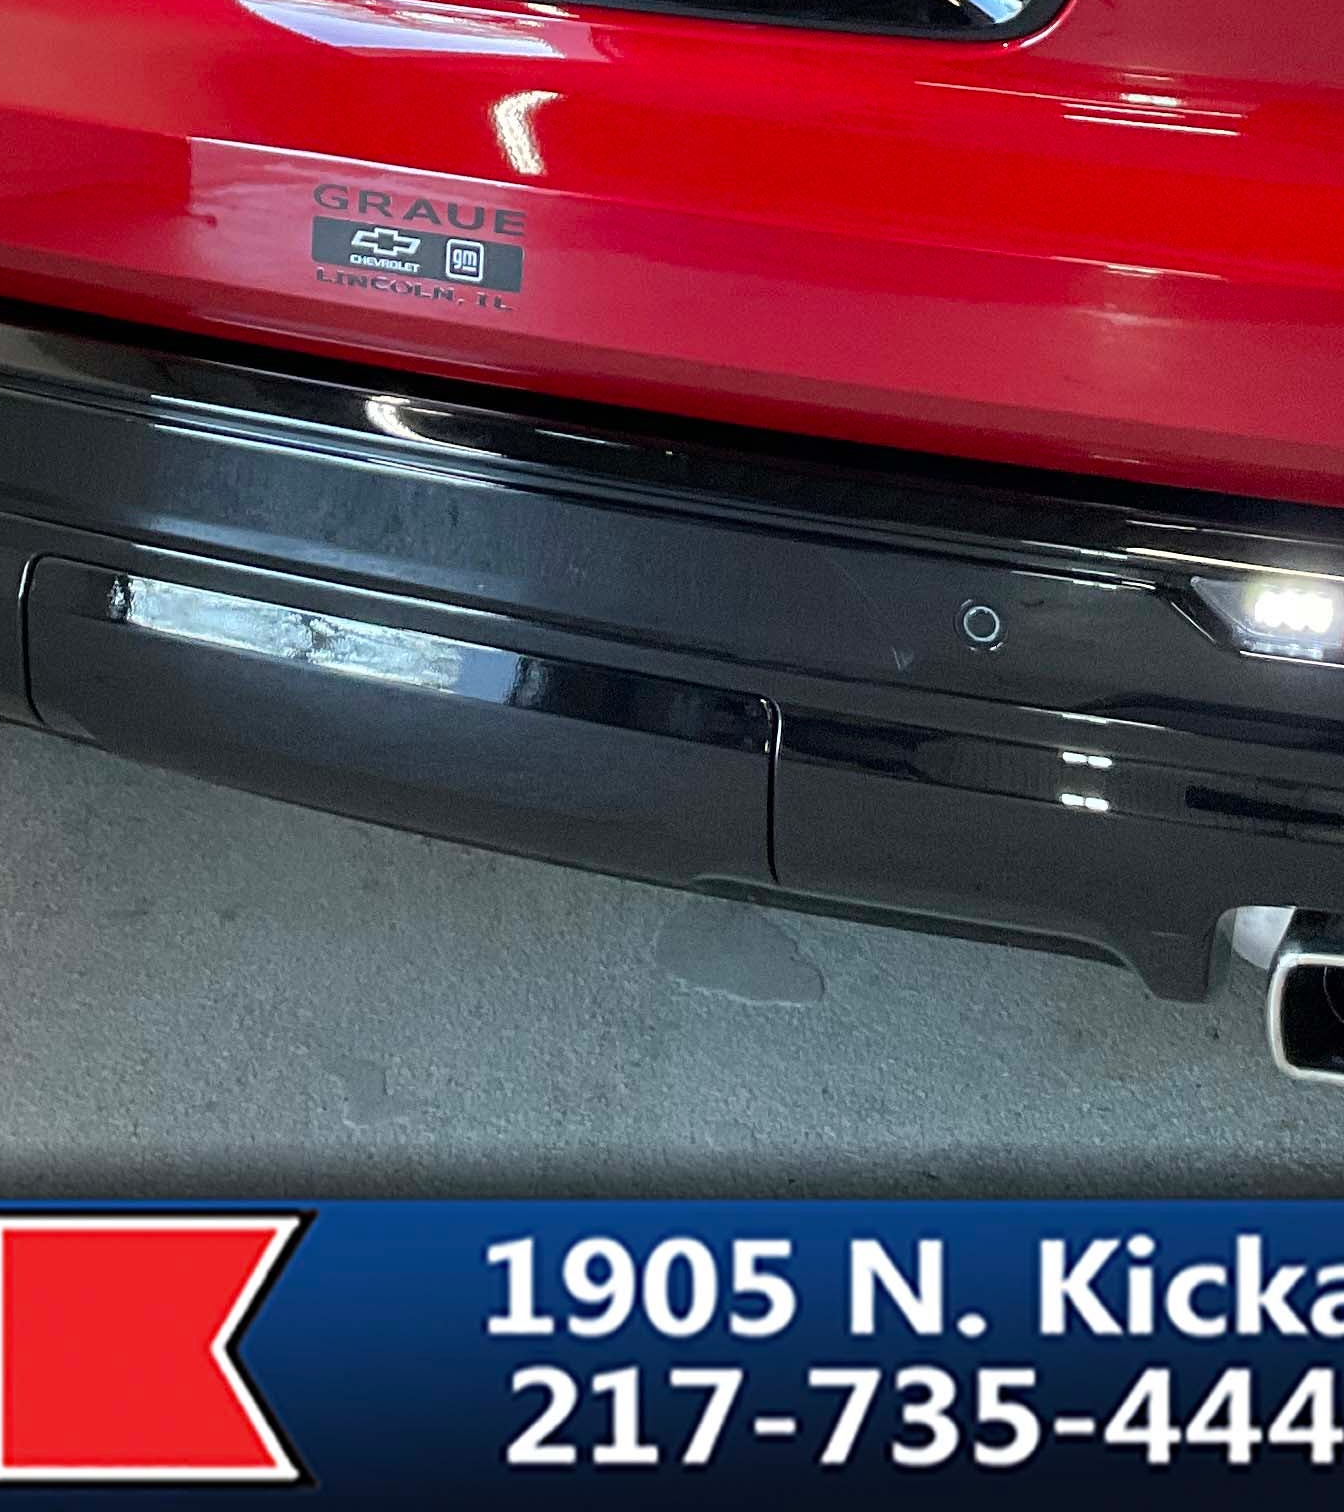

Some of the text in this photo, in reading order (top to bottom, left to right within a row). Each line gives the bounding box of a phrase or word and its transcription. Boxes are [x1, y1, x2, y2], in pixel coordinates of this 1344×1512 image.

[313, 183, 527, 236] GRAUE
[349, 253, 421, 274] CHEVROLET
[452, 247, 478, 272] gm
[315, 267, 513, 311] LINCOLN, IL
